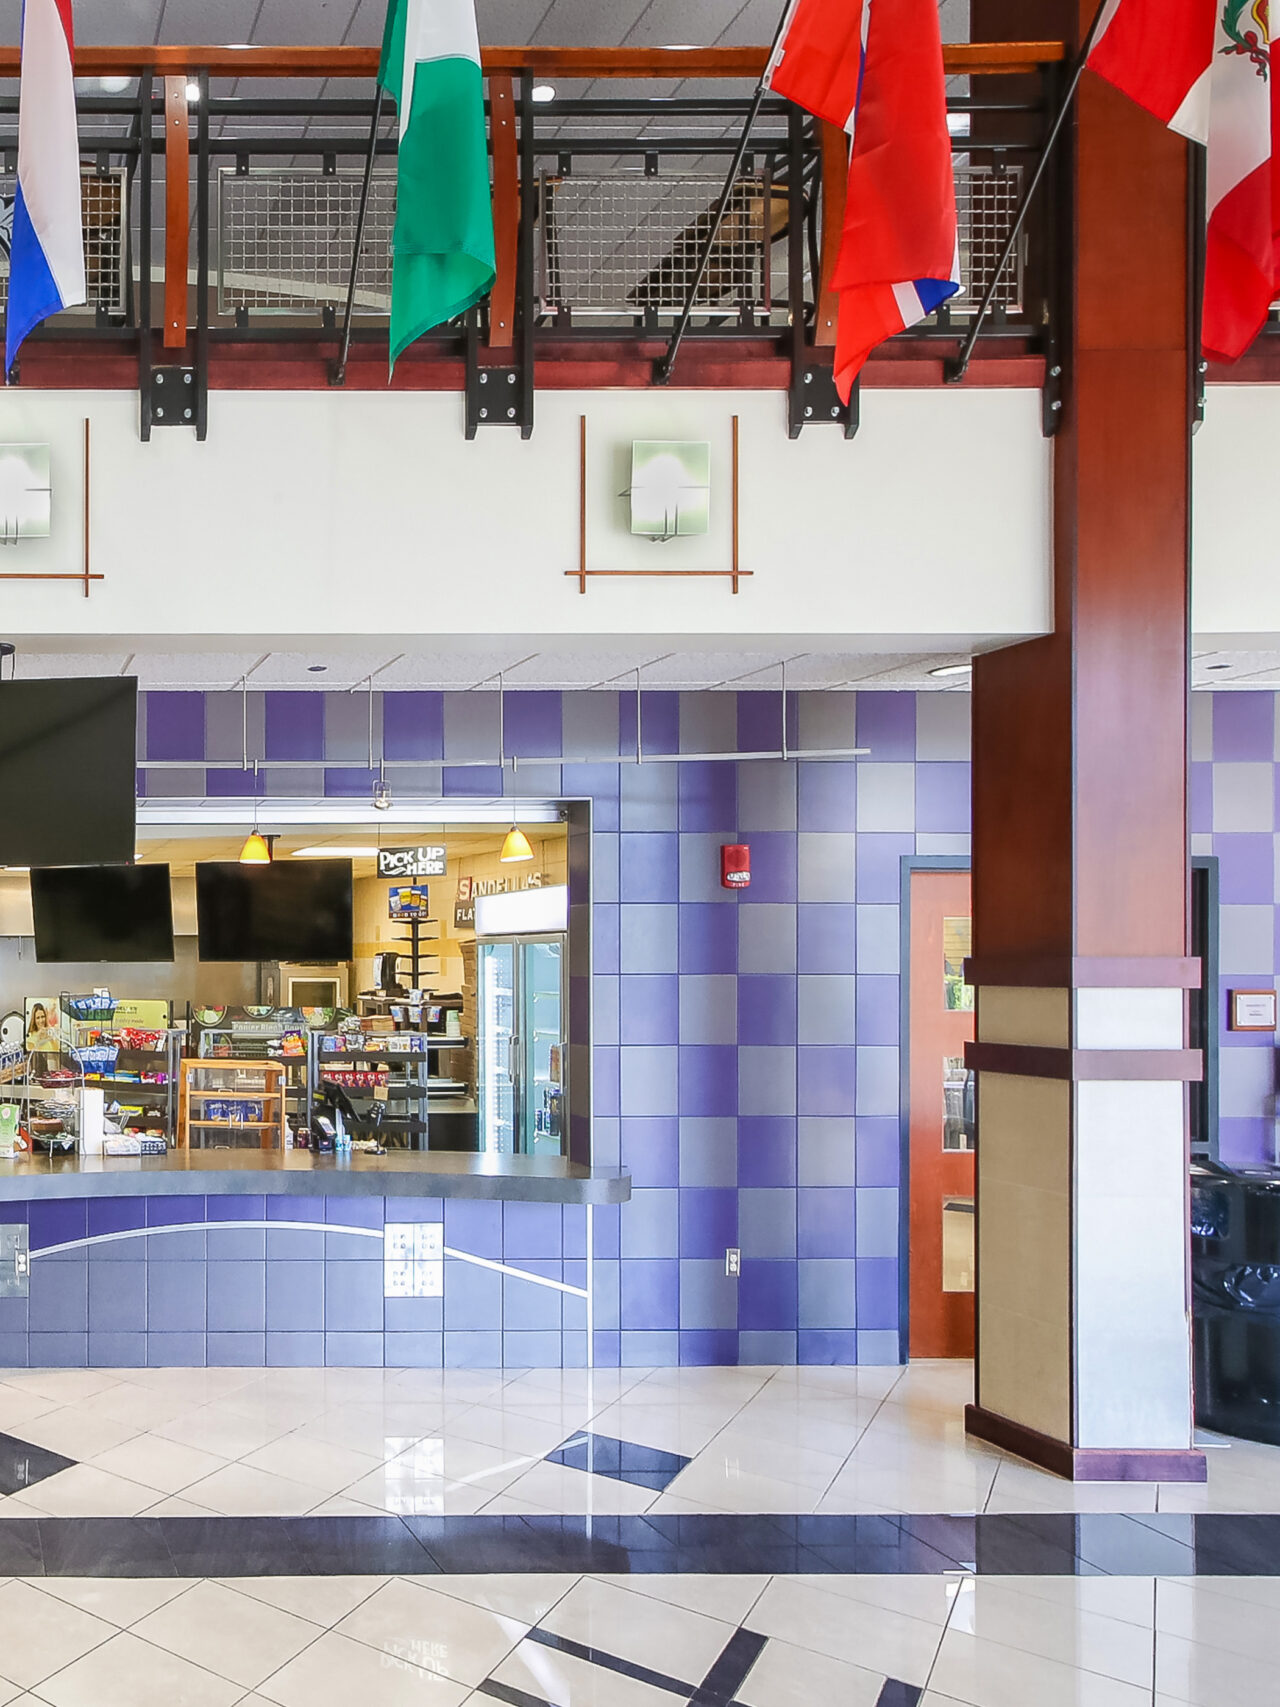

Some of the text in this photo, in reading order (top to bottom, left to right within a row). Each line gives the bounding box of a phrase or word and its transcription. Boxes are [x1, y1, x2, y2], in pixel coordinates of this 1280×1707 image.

[380, 846, 444, 871] PICK UP
[408, 861, 444, 875] HERE
